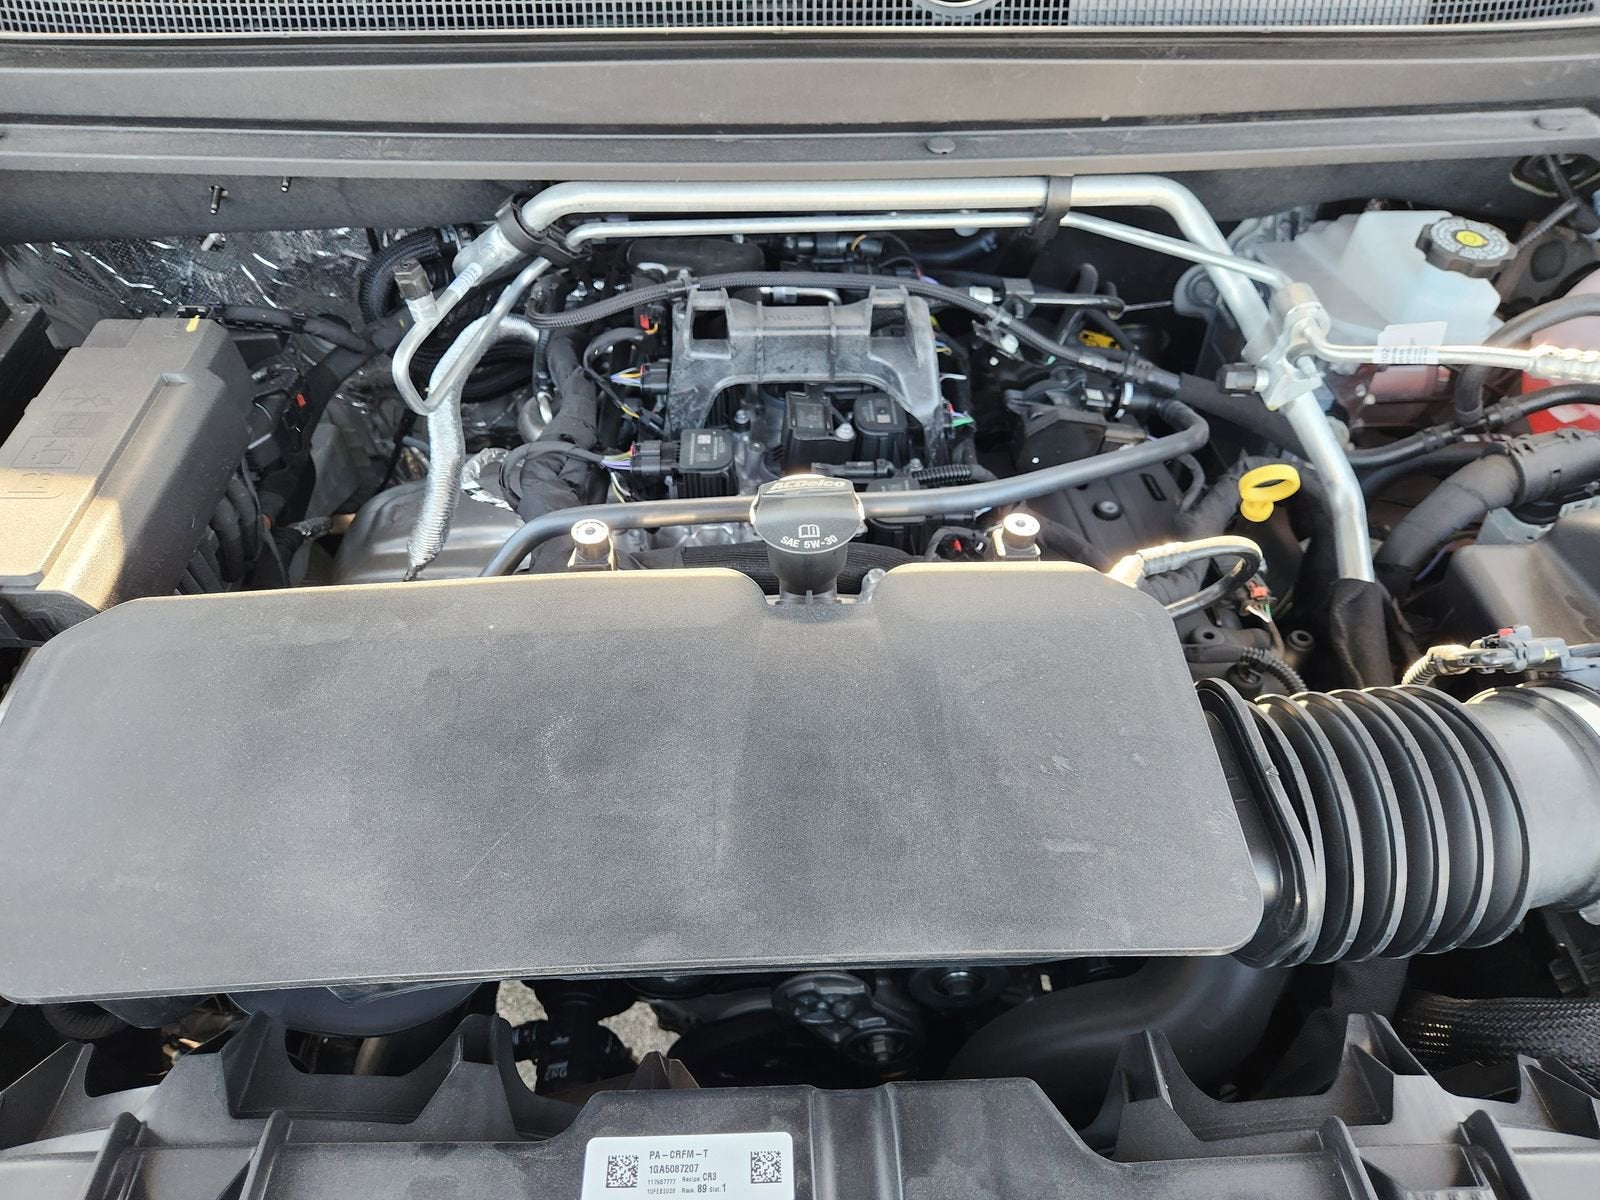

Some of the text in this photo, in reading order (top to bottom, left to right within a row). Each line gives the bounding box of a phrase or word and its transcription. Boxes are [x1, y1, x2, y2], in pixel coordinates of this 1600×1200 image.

[780, 534, 838, 549] SAE 5W-30
[649, 1149, 709, 1160] PA-CRFM-T
[649, 1163, 699, 1174] 1GA5087207
[702, 1172, 717, 1182] CR3
[697, 1184, 707, 1193] 89
[722, 1183, 727, 1193] 1
